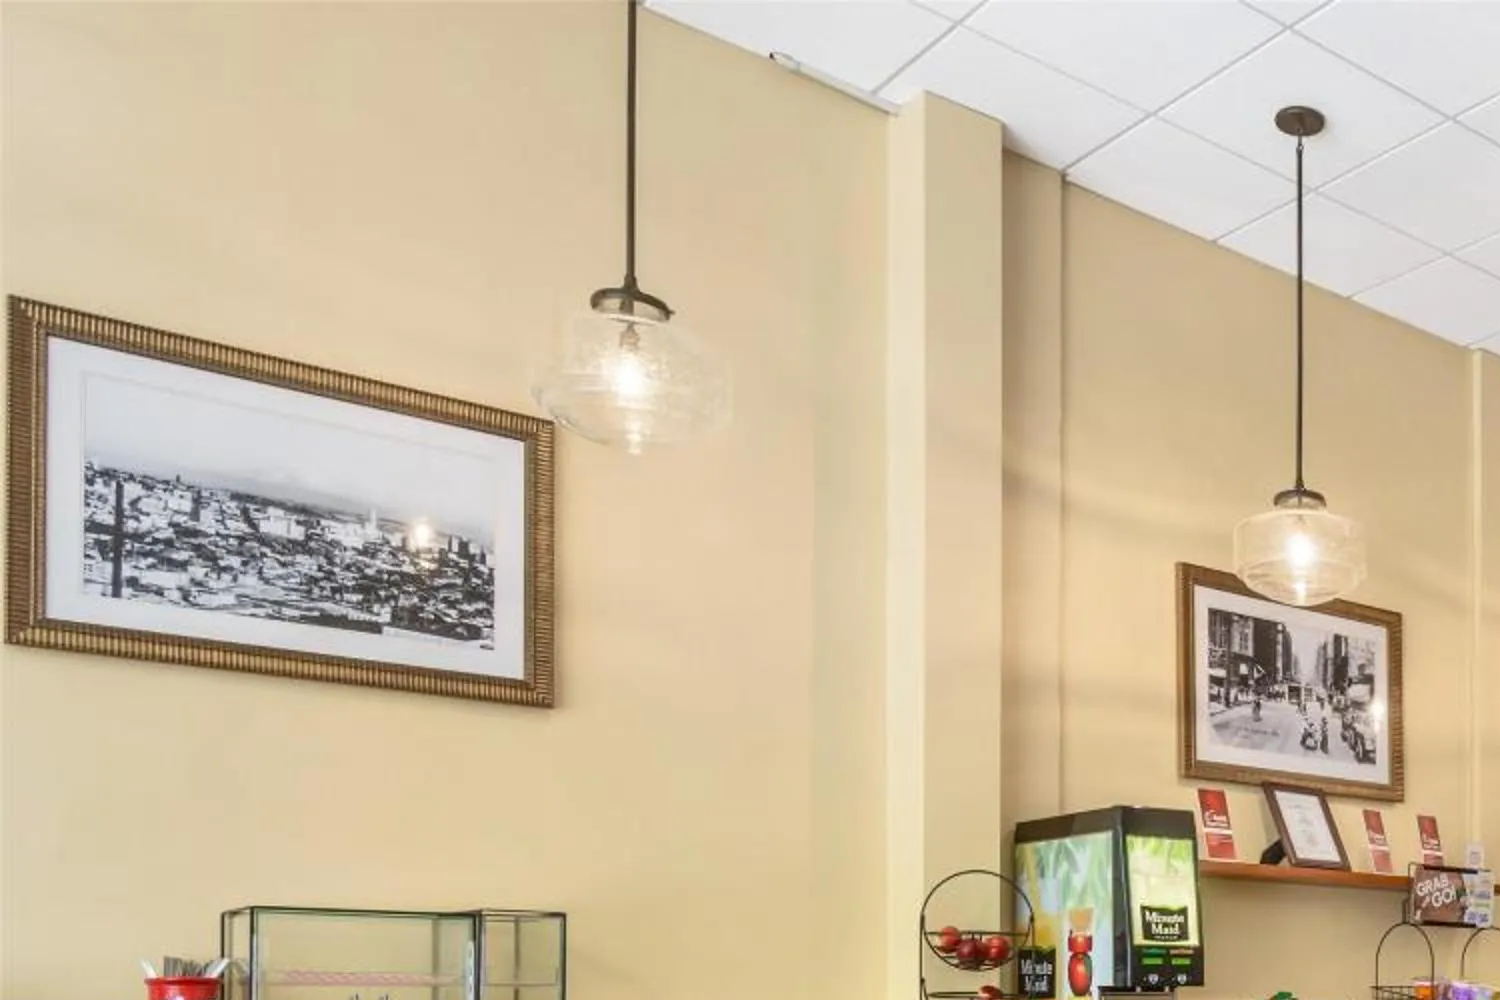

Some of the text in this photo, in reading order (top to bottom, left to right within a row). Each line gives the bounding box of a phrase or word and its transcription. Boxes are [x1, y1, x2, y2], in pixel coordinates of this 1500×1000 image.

[1416, 873, 1449, 897] GRAB
[1144, 910, 1184, 923] Minute
[1151, 923, 1180, 934] Maid
